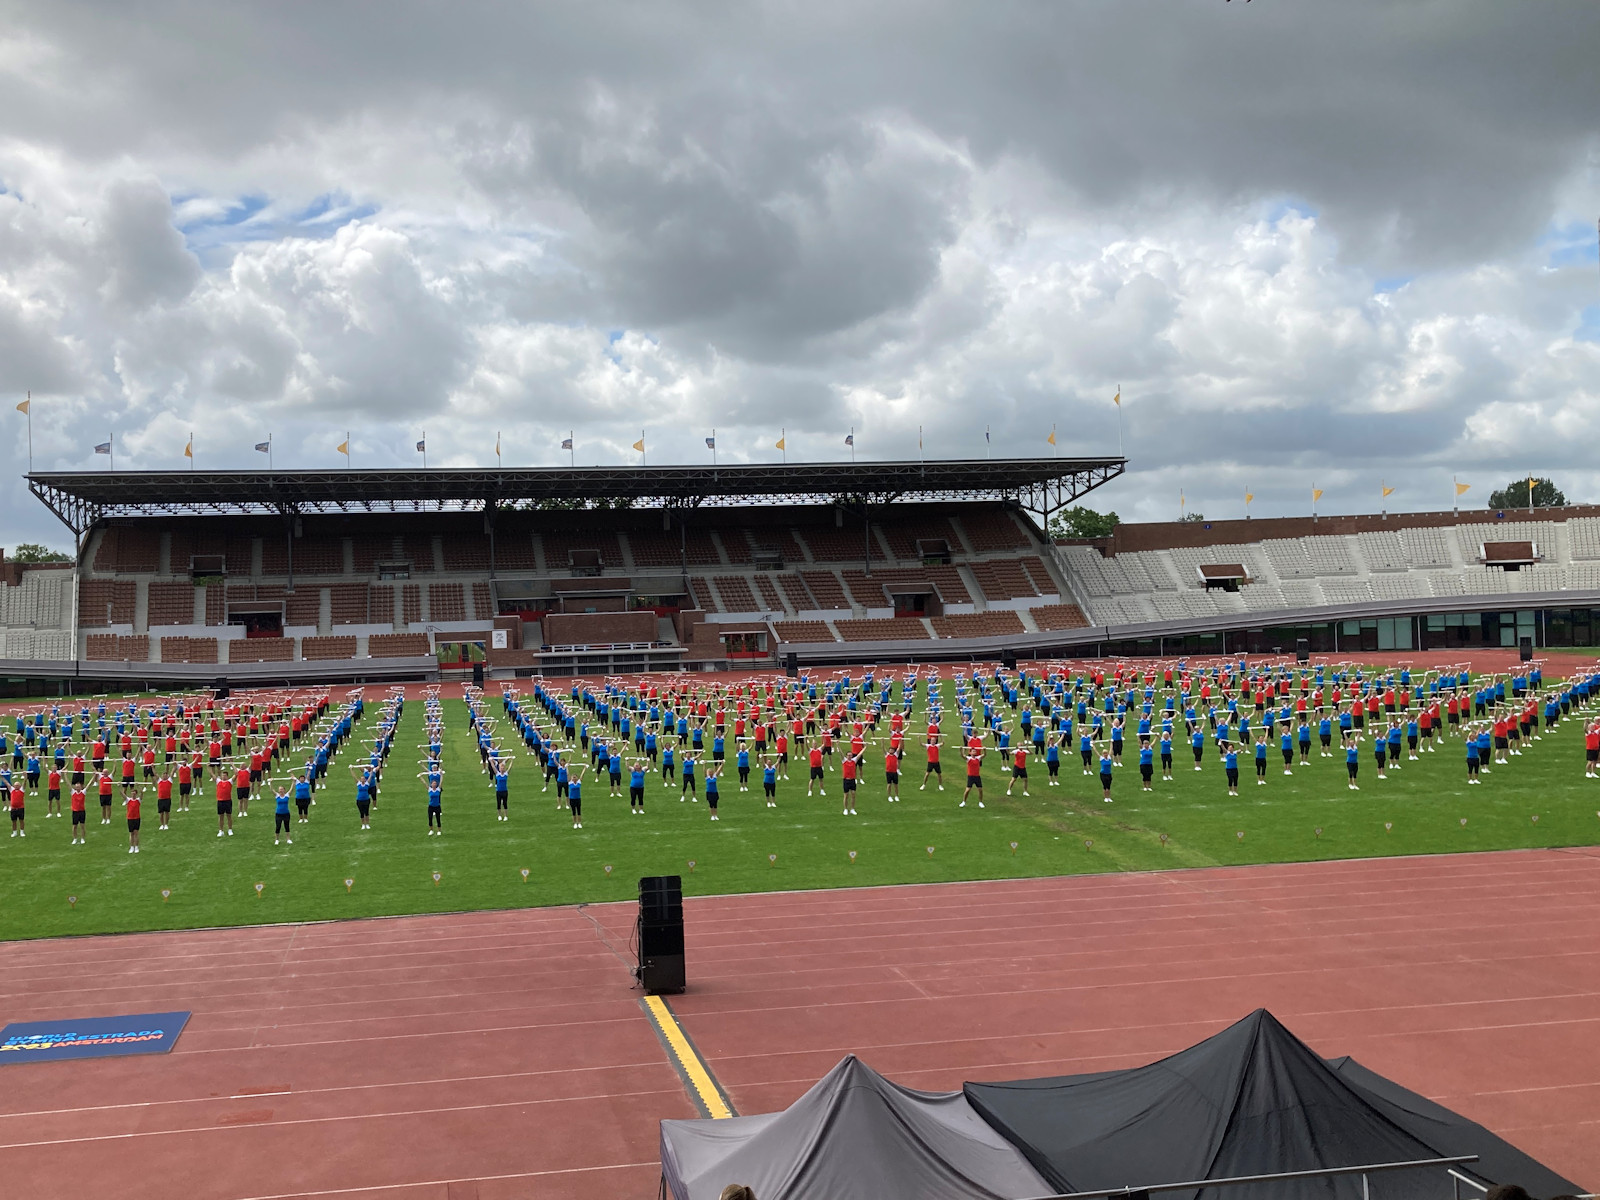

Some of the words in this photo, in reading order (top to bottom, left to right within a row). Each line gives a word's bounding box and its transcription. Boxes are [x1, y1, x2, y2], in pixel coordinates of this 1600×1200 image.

[4, 1029, 164, 1045] GYMNAESTRADA
[9, 1033, 77, 1041] WORLD
[52, 1034, 164, 1047] AMSTERDAM
